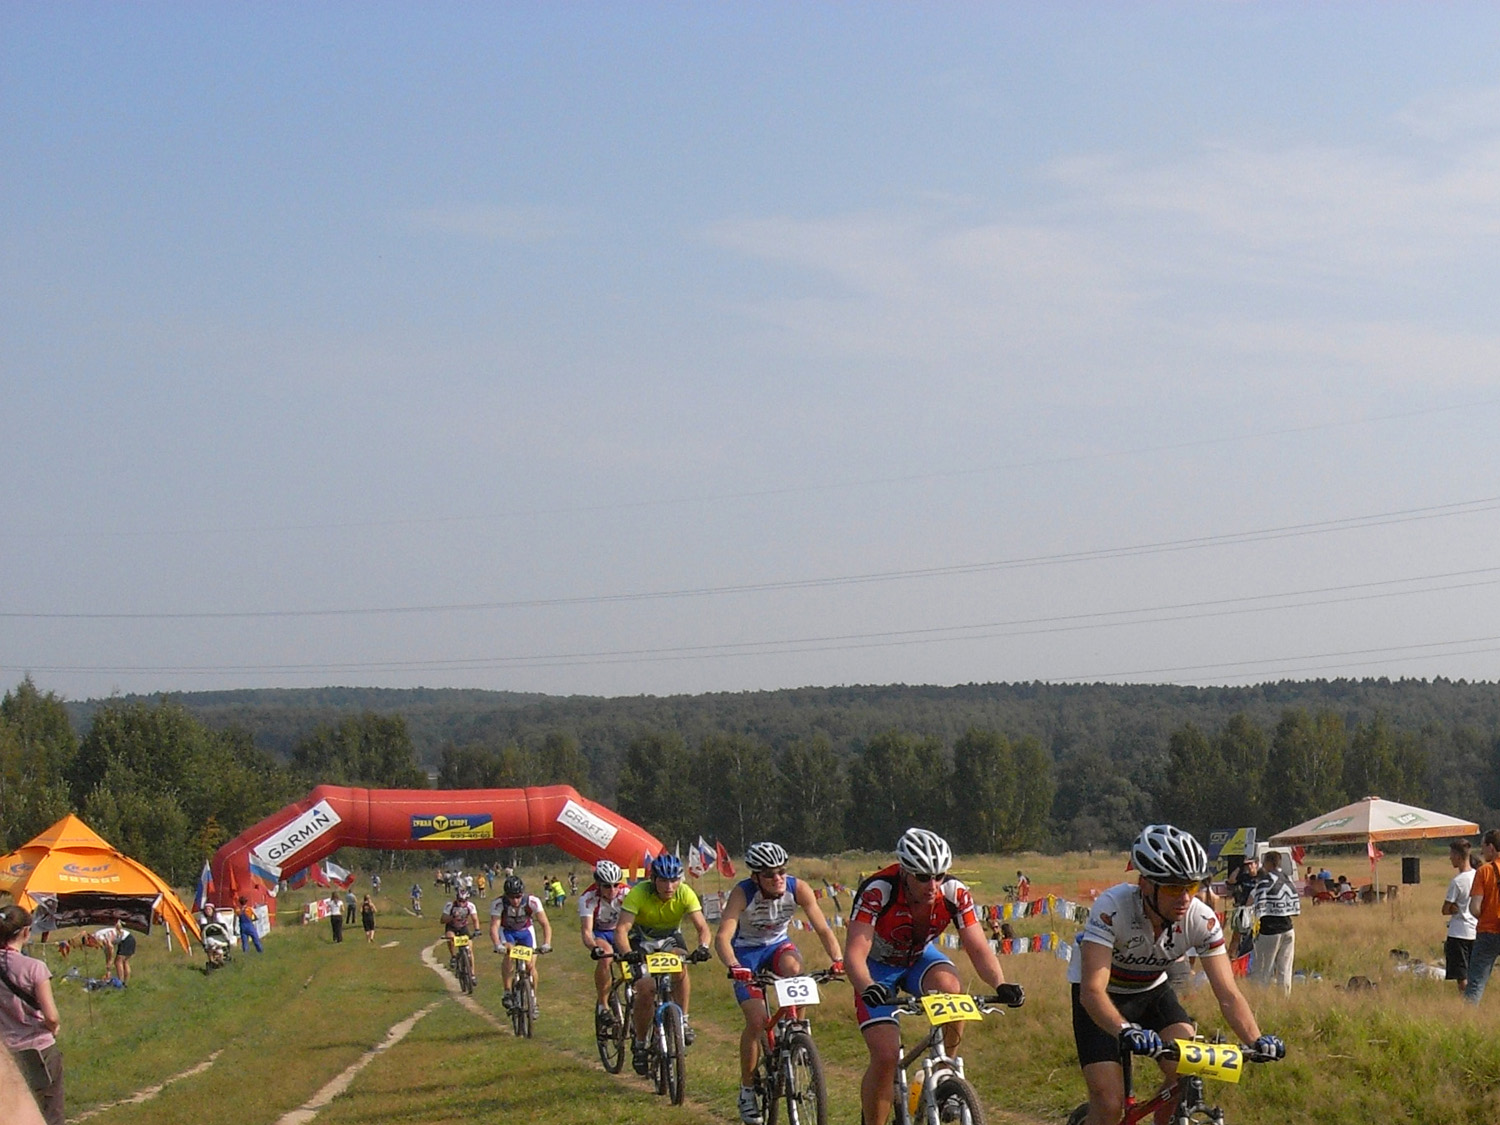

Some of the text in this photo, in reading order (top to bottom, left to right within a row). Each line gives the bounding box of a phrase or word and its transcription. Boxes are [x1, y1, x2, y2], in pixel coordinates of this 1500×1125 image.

[564, 808, 605, 835] CRAFT
[267, 813, 331, 860] GARMIN
[650, 957, 679, 967] 220
[1111, 947, 1176, 967] Raboba
[786, 984, 810, 998] 63
[930, 1001, 974, 1017] 210
[1185, 1045, 1238, 1070] 312
